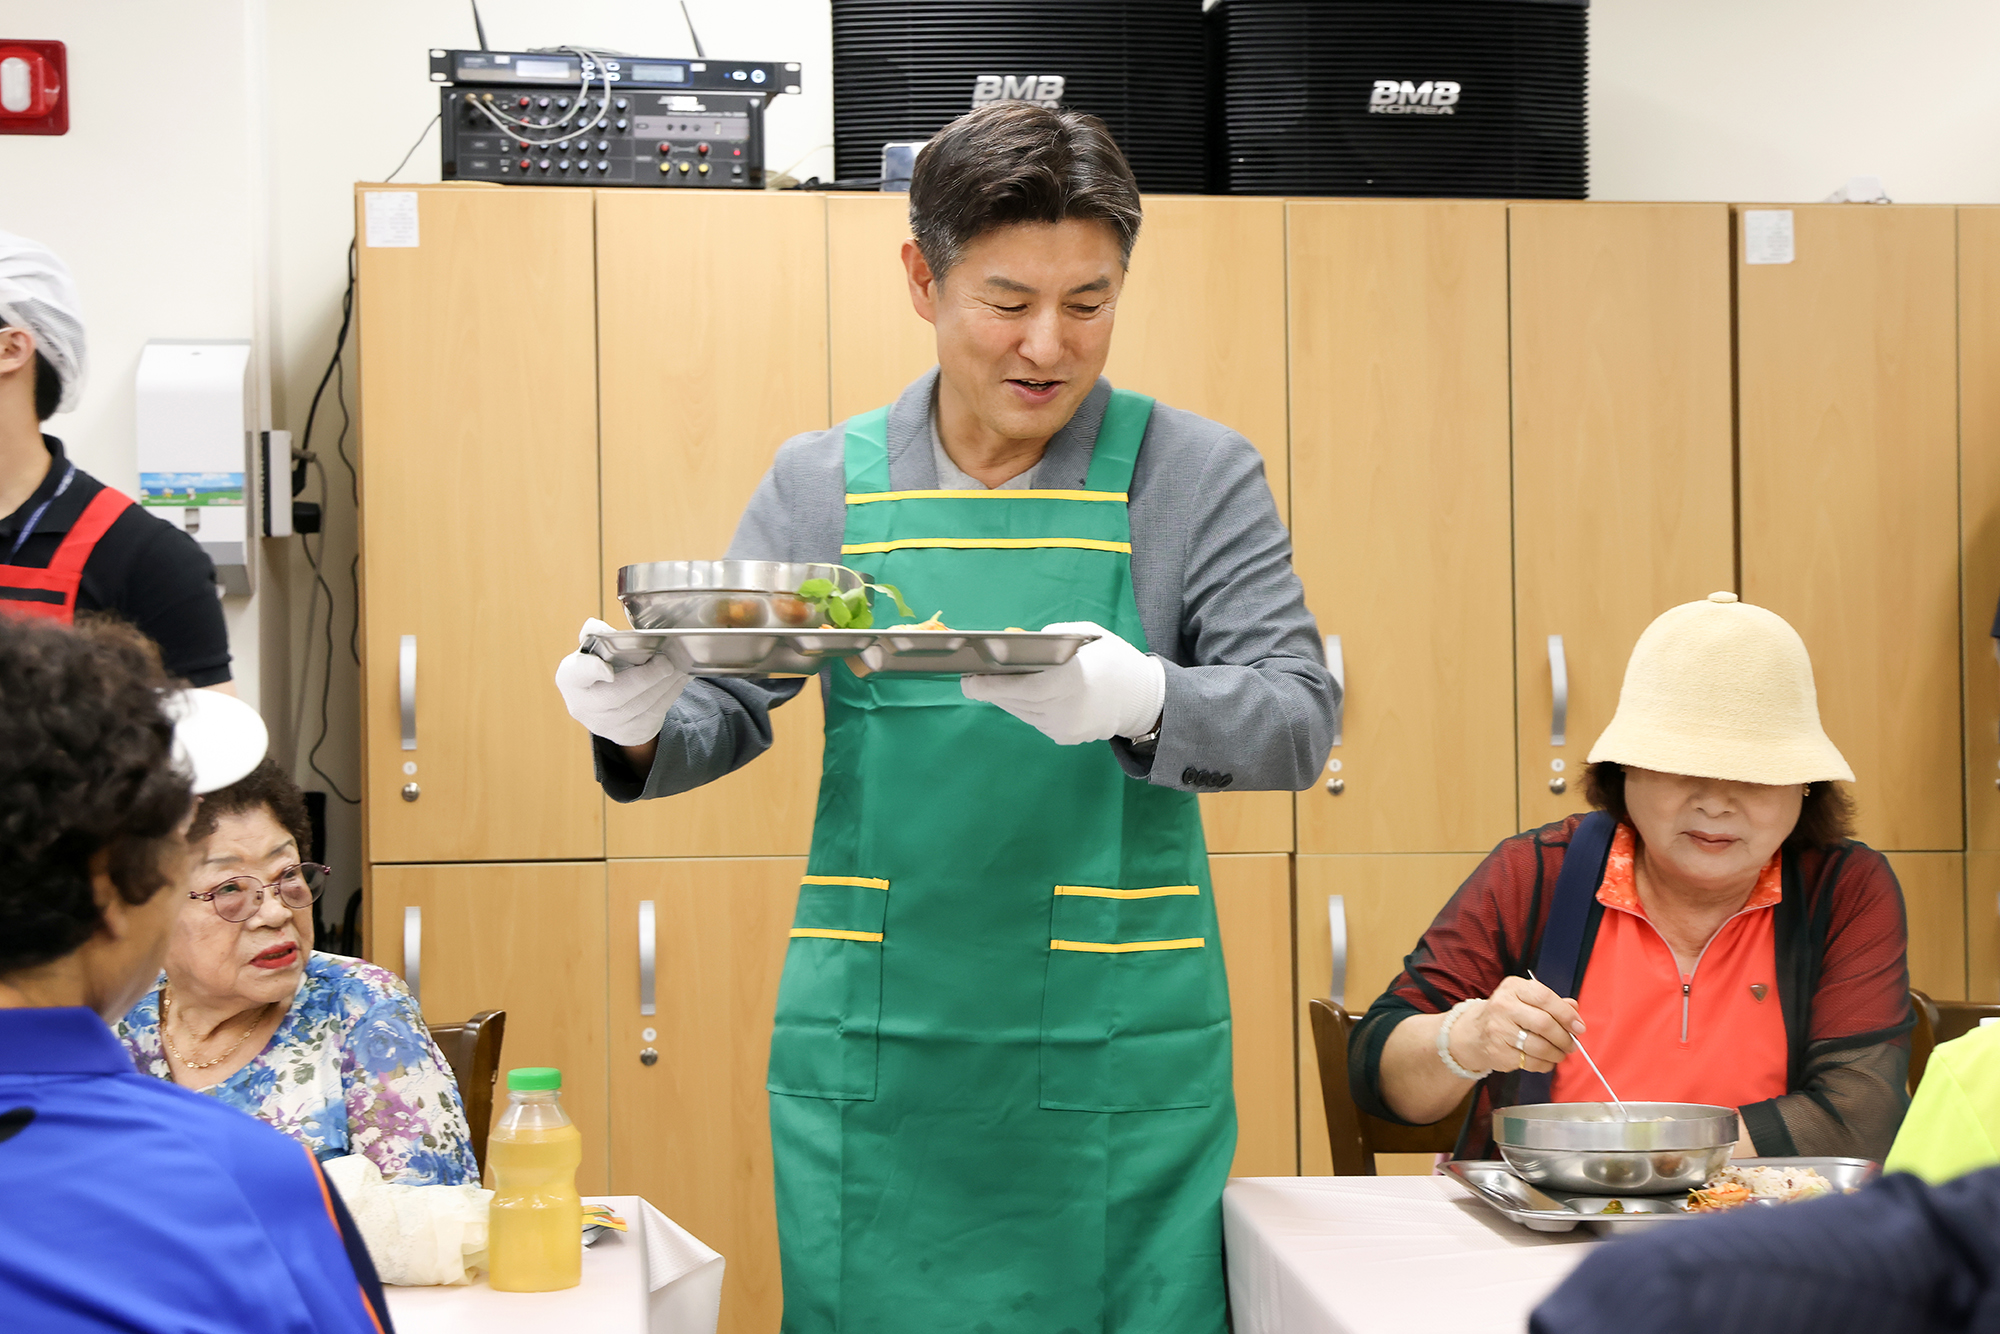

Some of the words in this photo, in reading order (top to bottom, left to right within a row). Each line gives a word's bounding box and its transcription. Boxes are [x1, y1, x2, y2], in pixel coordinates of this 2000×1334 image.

[972, 75, 1065, 100] BMB
[1369, 80, 1461, 105] BMB
[1368, 105, 1455, 114] KOREA
